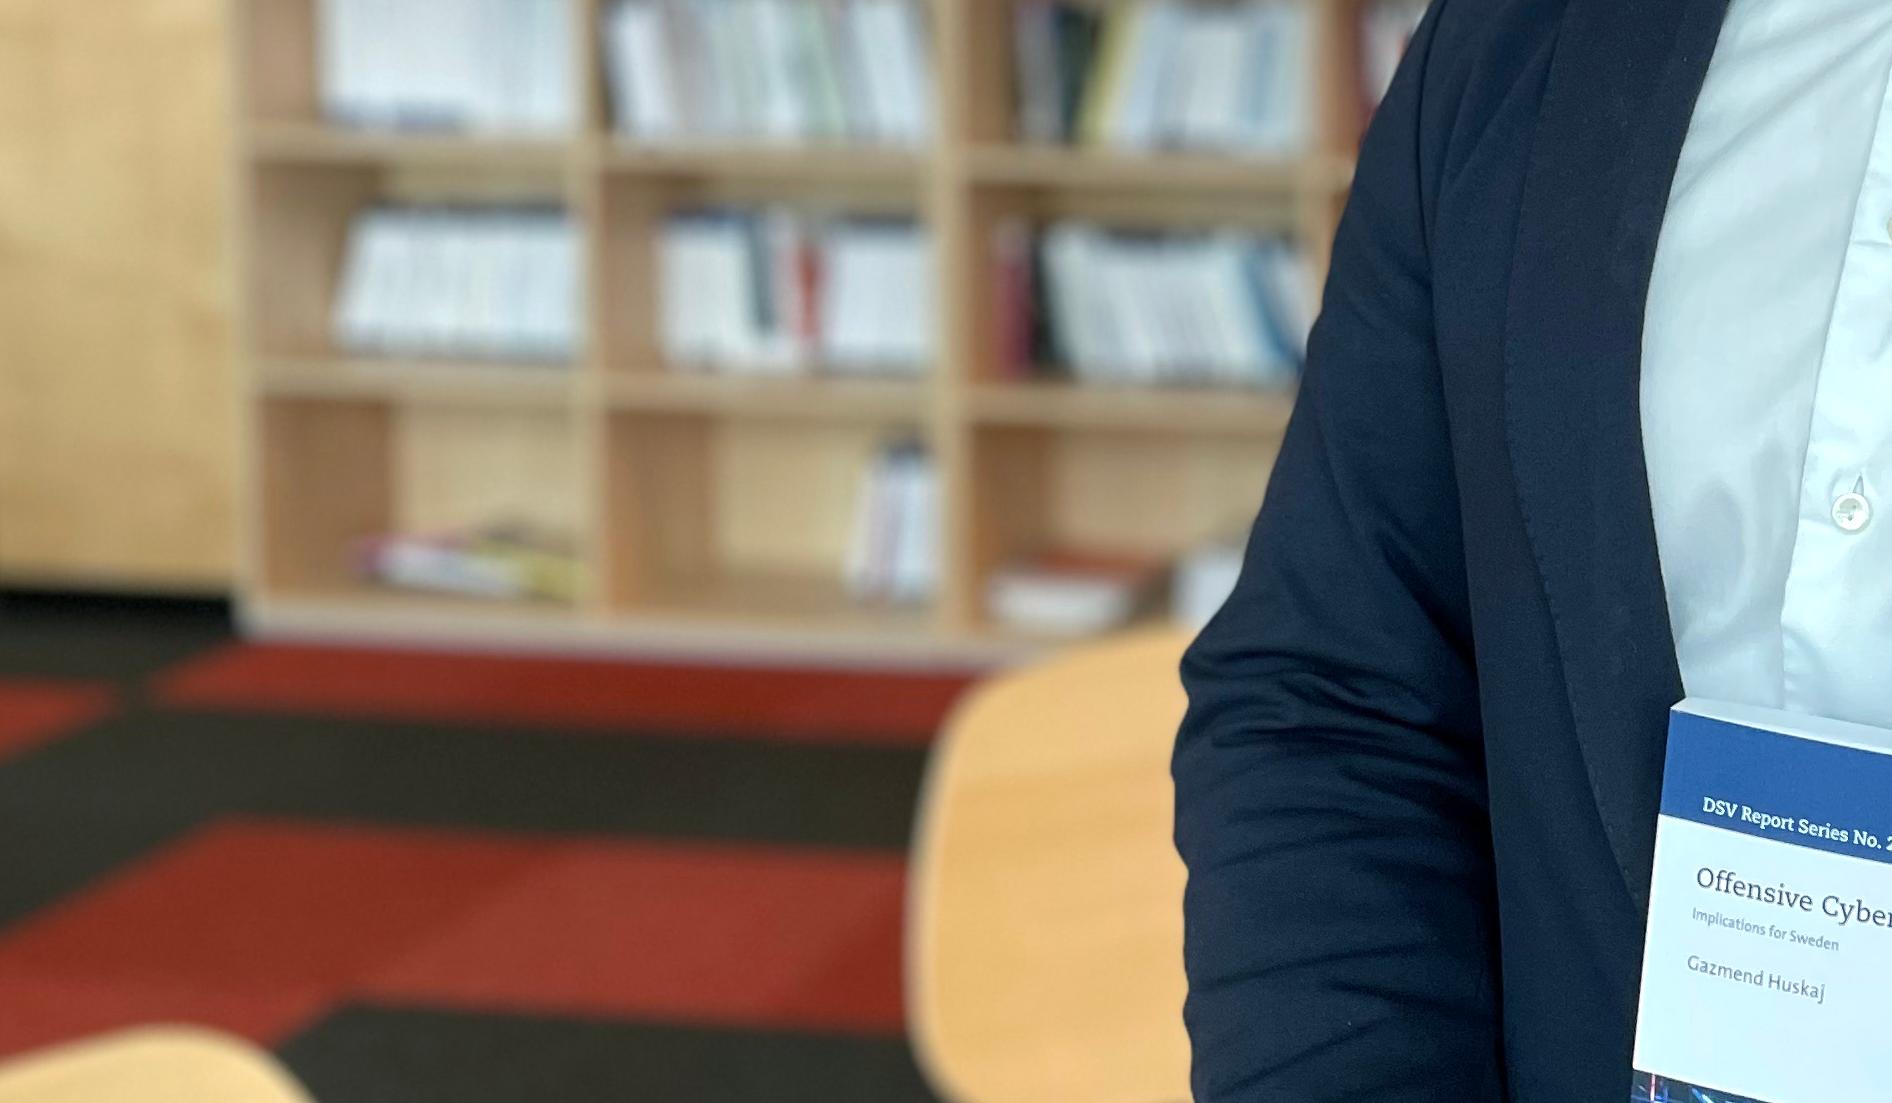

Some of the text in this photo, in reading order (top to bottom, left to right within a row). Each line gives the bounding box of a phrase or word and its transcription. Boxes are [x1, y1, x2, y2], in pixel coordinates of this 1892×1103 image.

[1702, 796, 1738, 818] DSV
[1740, 805, 1795, 830] Report
[1798, 818, 1849, 842] Series
[1852, 829, 1882, 849] No.
[1697, 867, 1814, 912] Offensive
[1692, 907, 1839, 951] Implications for Sweden
[1687, 955, 1826, 1005] Gazmend Huskaj
